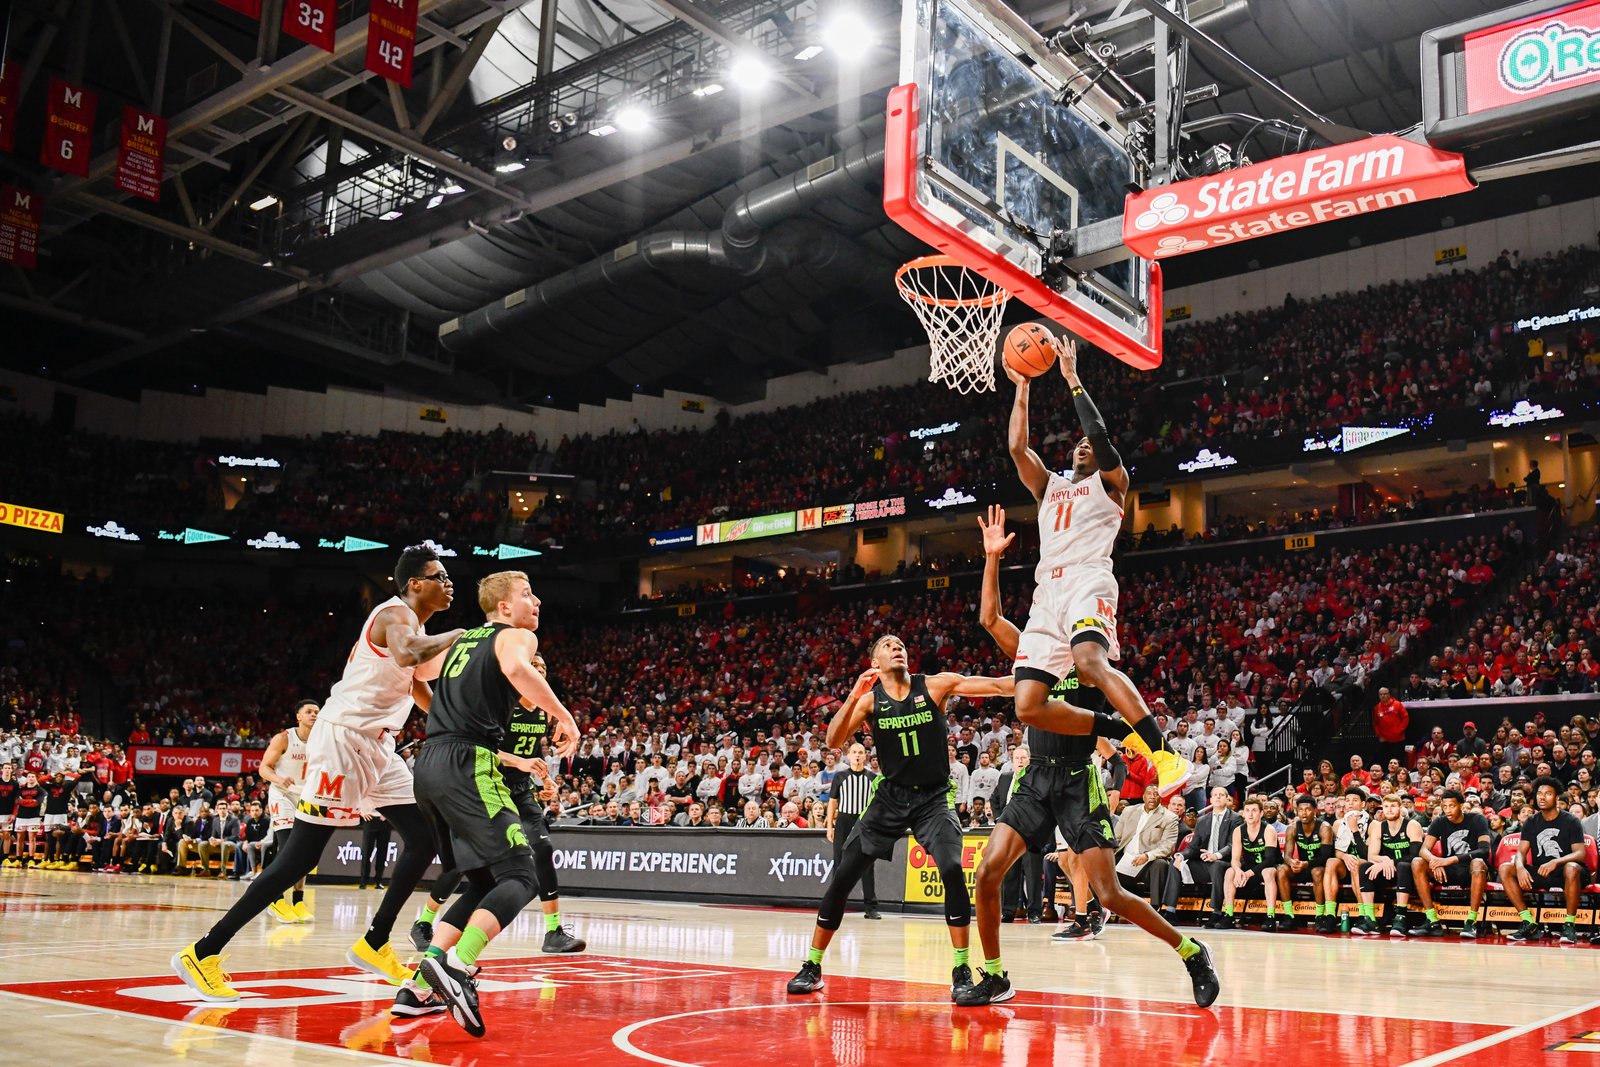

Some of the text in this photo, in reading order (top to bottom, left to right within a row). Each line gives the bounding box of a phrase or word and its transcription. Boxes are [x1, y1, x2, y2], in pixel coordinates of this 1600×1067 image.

[298, 2, 325, 33] 32
[379, 40, 403, 70] 42
[64, 86, 82, 109] M
[50, 114, 89, 134] BERGER
[136, 114, 154, 135] M
[61, 139, 73, 160] 6
[1193, 146, 1404, 218] State Farm
[14, 191, 31, 210] M
[1206, 188, 1417, 243] State Farm
[1440, 246, 1460, 258] 201
[1016, 339, 1030, 353] M
[855, 501, 878, 512] HOME
[879, 499, 890, 508] OF
[890, 497, 905, 507] THE
[855, 504, 906, 521] TERRAPINS
[13, 508, 61, 531] PIZZA
[775, 517, 793, 529] DEW
[803, 509, 815, 526] M
[1053, 502, 1074, 532] 11
[702, 525, 715, 541] M
[1291, 537, 1309, 548] 101
[931, 578, 945, 587] 102
[1053, 569, 1060, 577] M
[1096, 598, 1115, 624] M
[510, 722, 546, 734] SPARTANS
[878, 710, 934, 730] SPARTANS
[513, 736, 537, 756] 23
[898, 730, 920, 757] 11
[161, 756, 209, 767] TOYOTA
[317, 771, 346, 799] M
[271, 803, 279, 815] M
[590, 850, 626, 870] WIFI
[629, 851, 738, 875] EXPERIENCE
[1255, 853, 1262, 864] 3
[1307, 850, 1315, 860] 2
[768, 851, 835, 884] xfinity
